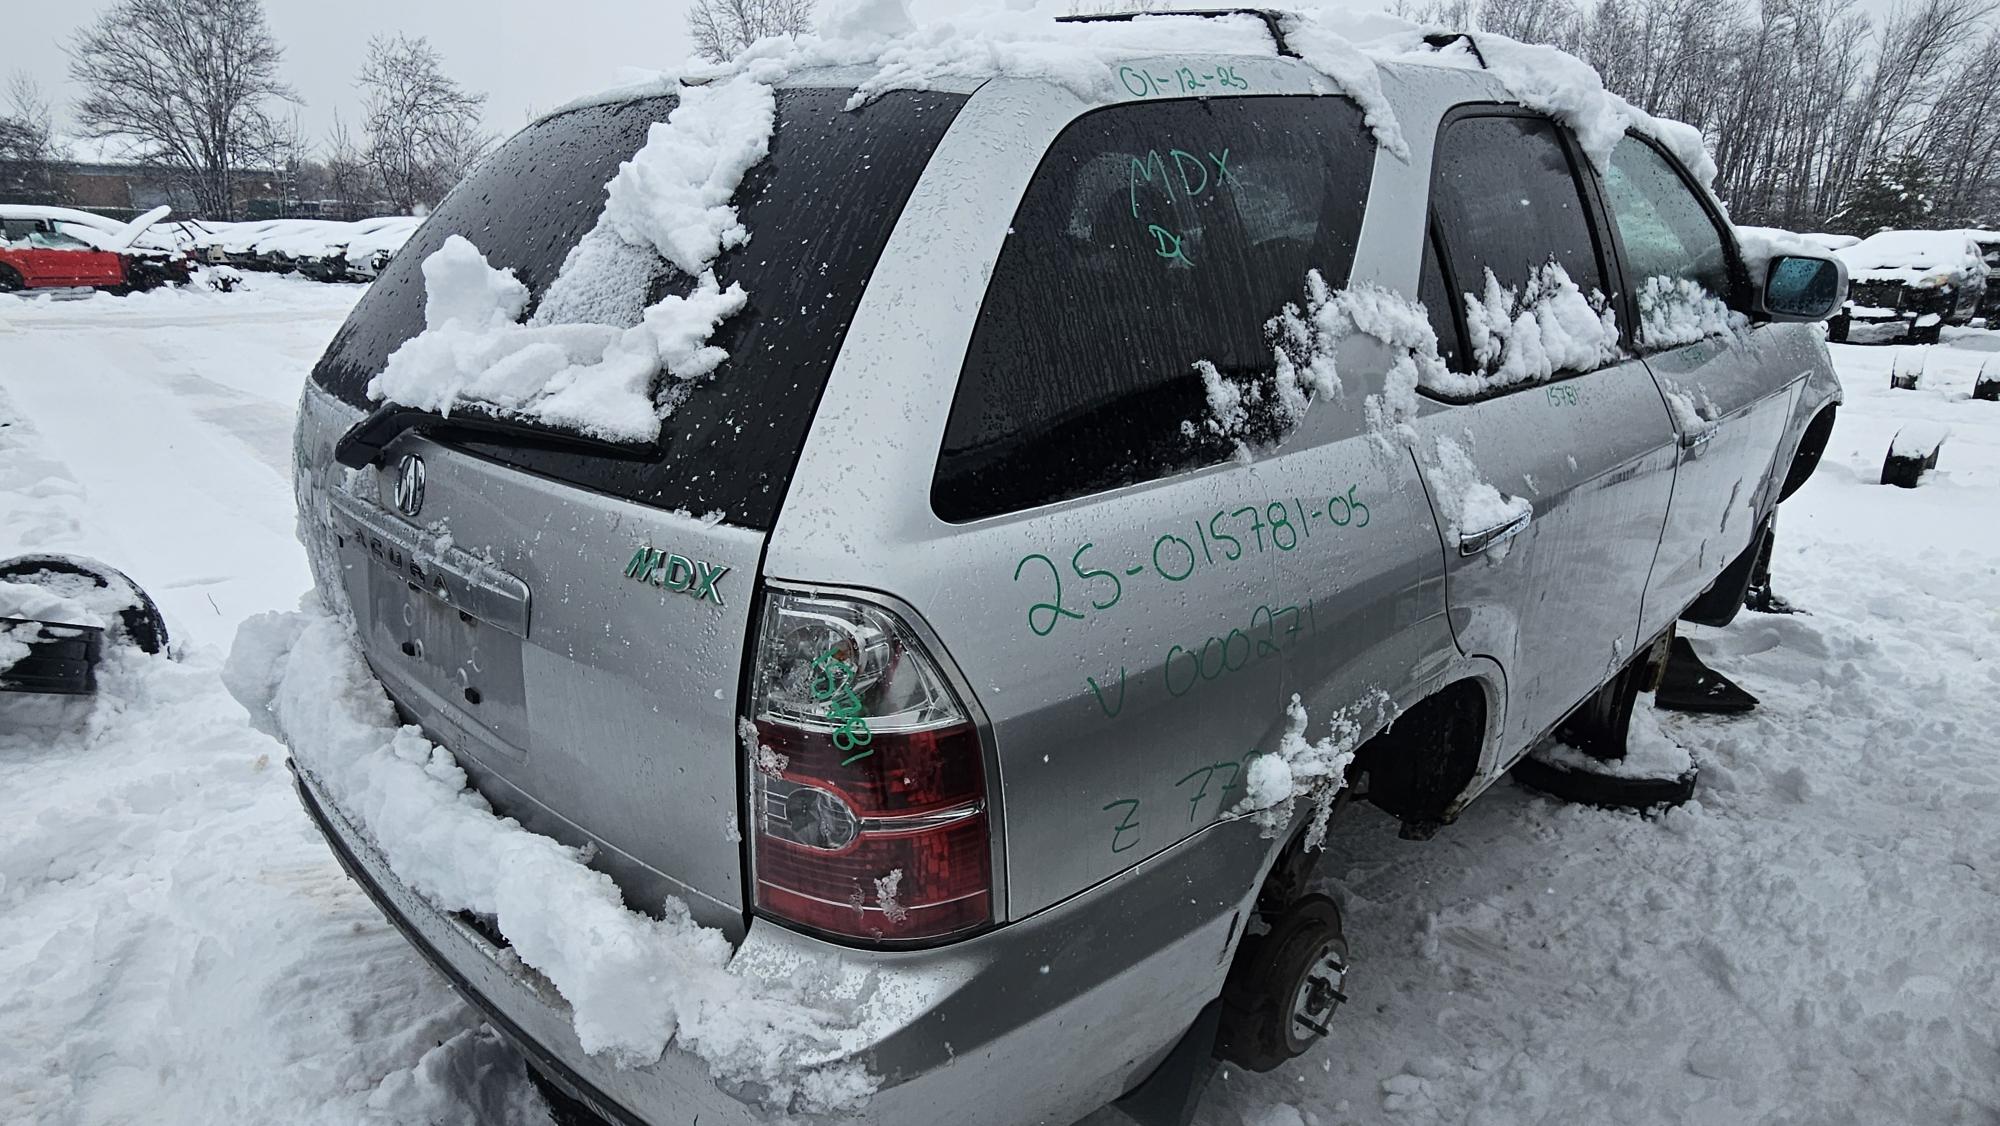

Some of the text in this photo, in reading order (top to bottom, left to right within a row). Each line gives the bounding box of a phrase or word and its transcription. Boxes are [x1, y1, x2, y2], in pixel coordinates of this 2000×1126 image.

[1119, 65, 1249, 97] 01-12-25
[1130, 148, 1245, 219] MDX
[624, 545, 731, 606] MDX
[1013, 484, 1371, 637] 25-015781-05
[1165, 599, 1317, 698] 000271
